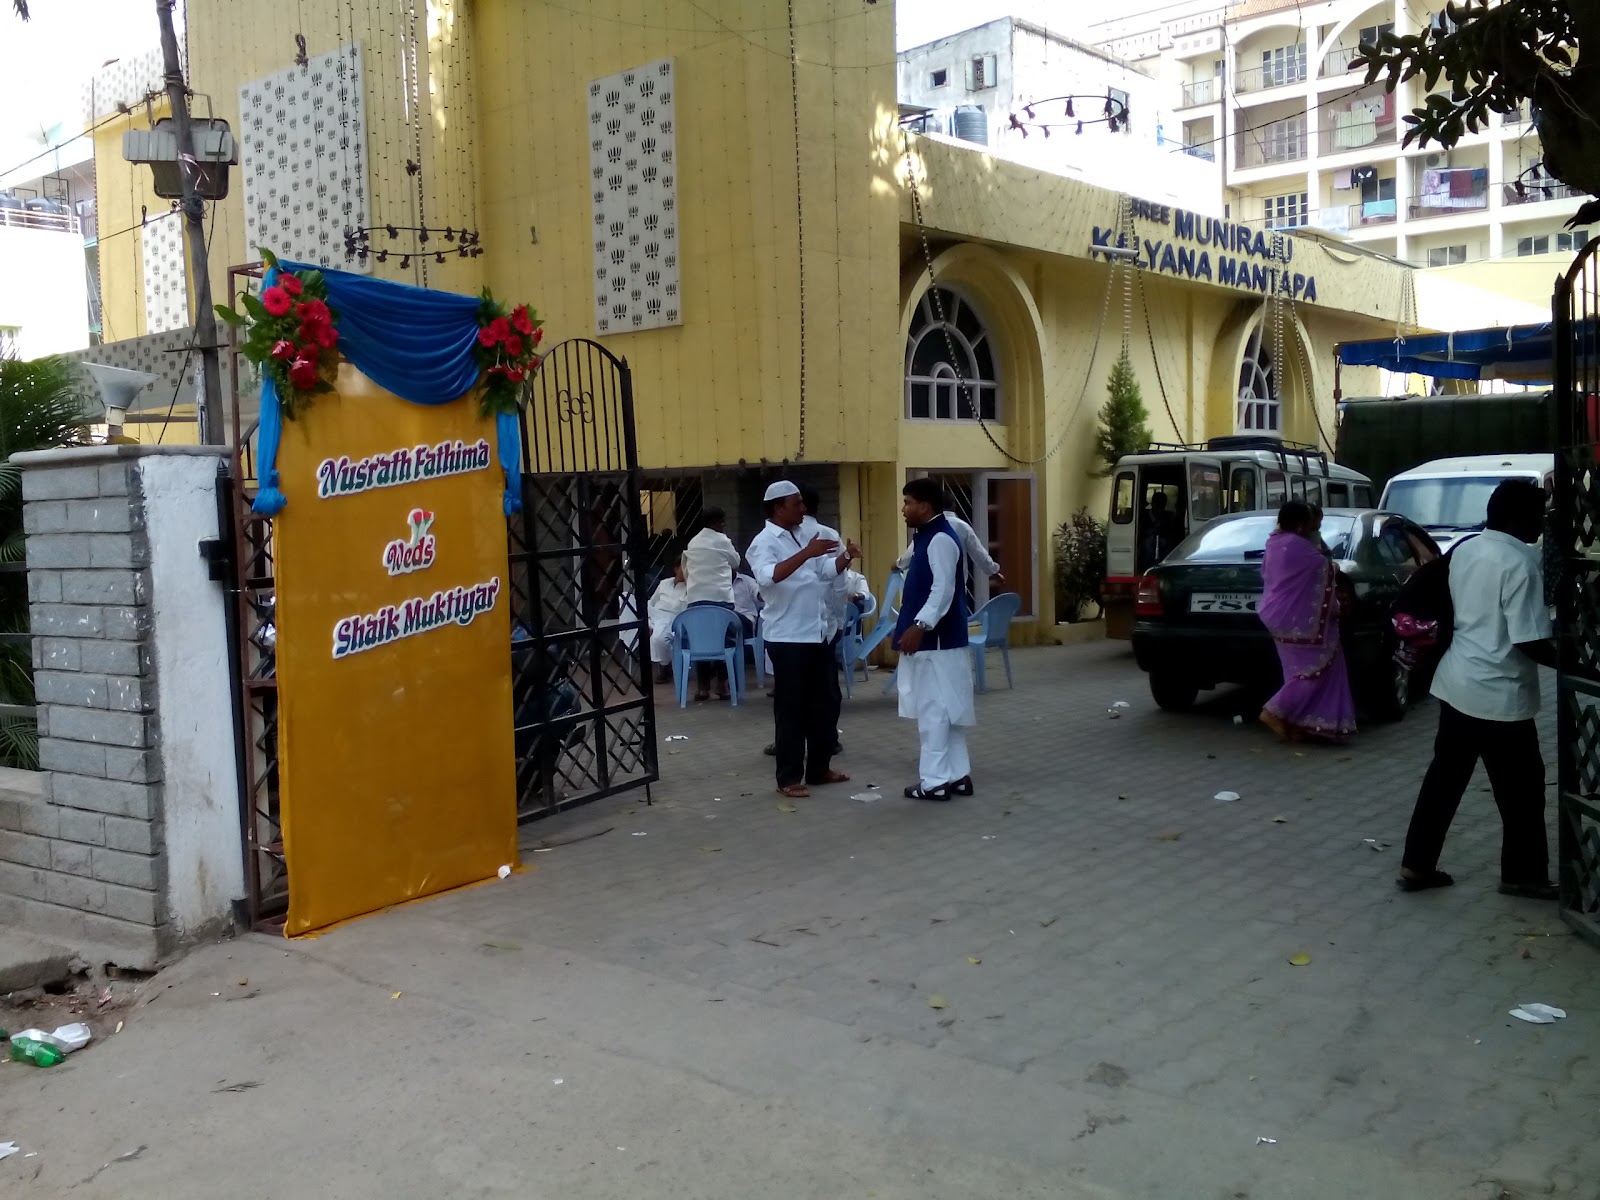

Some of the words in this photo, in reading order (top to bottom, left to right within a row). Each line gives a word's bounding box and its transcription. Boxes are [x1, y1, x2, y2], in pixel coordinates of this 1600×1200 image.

[1218, 255, 1317, 304] MANTAPA
[319, 450, 412, 497] Nusrath
[414, 440, 490, 480] Fathima
[386, 536, 435, 572] Weds
[335, 606, 401, 656] Shaik
[403, 577, 499, 636] Muktiyar
